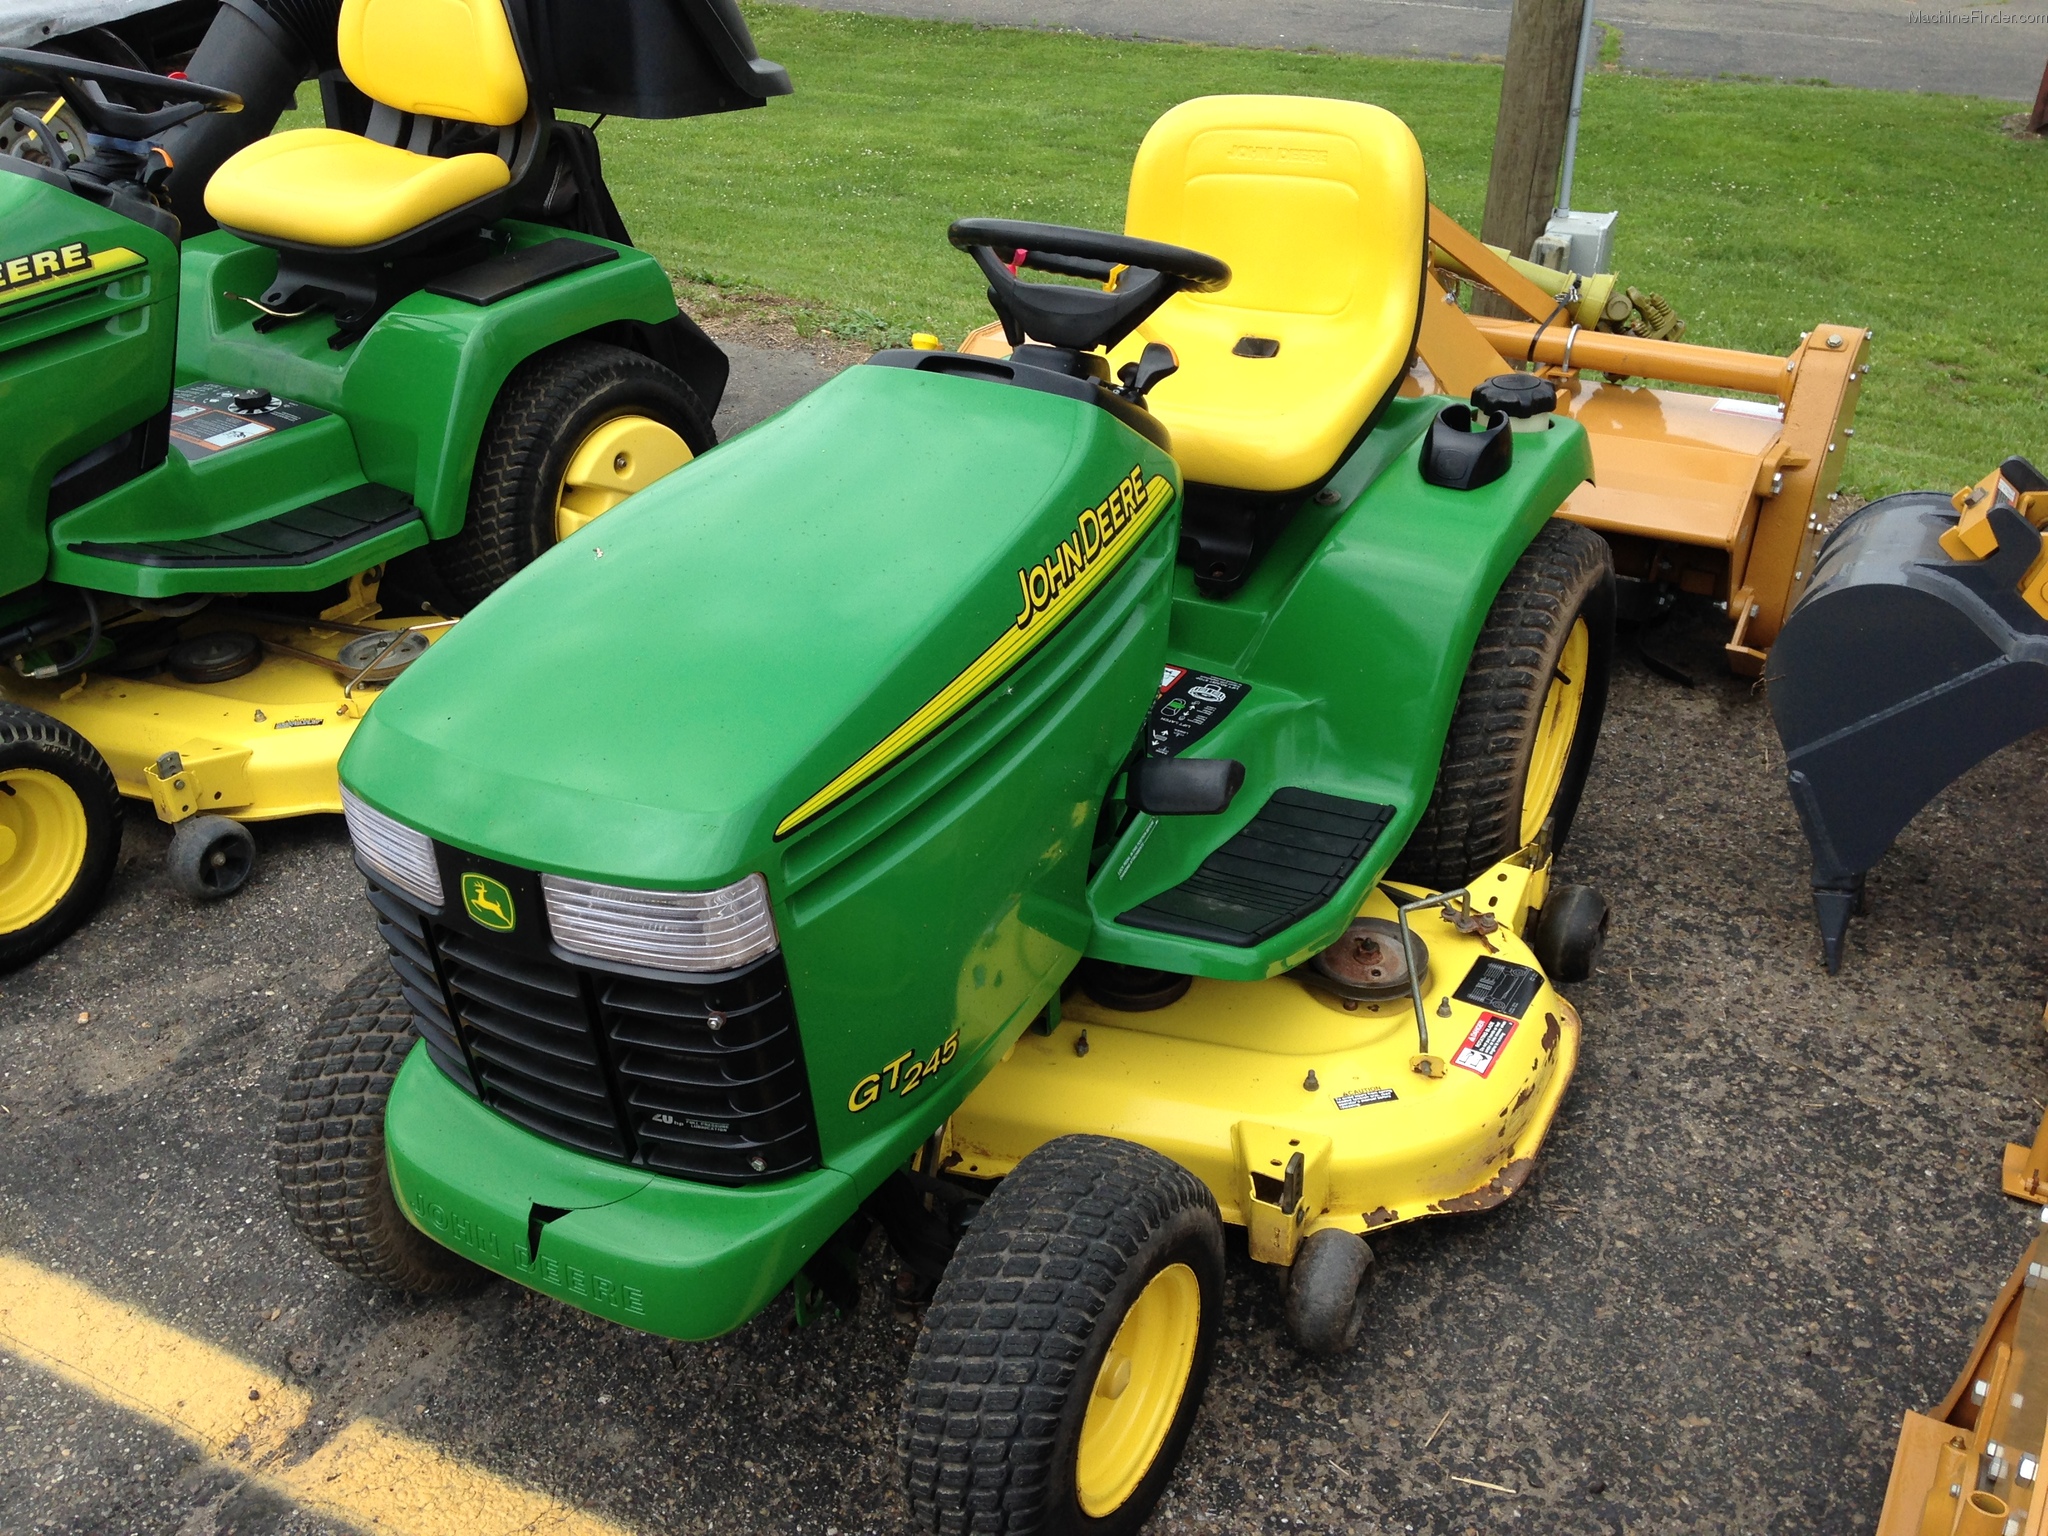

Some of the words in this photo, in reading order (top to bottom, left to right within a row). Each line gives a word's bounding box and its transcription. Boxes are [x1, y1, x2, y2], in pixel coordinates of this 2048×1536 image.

[0, 241, 92, 290] ERE
[1016, 529, 1087, 631] JOHN
[1078, 464, 1148, 564] DEERE
[1470, 1018, 1486, 1038] DANGER
[1347, 1086, 1382, 1097] CAUTION
[409, 1192, 500, 1260] JOHN
[512, 1242, 646, 1317] DEERE
